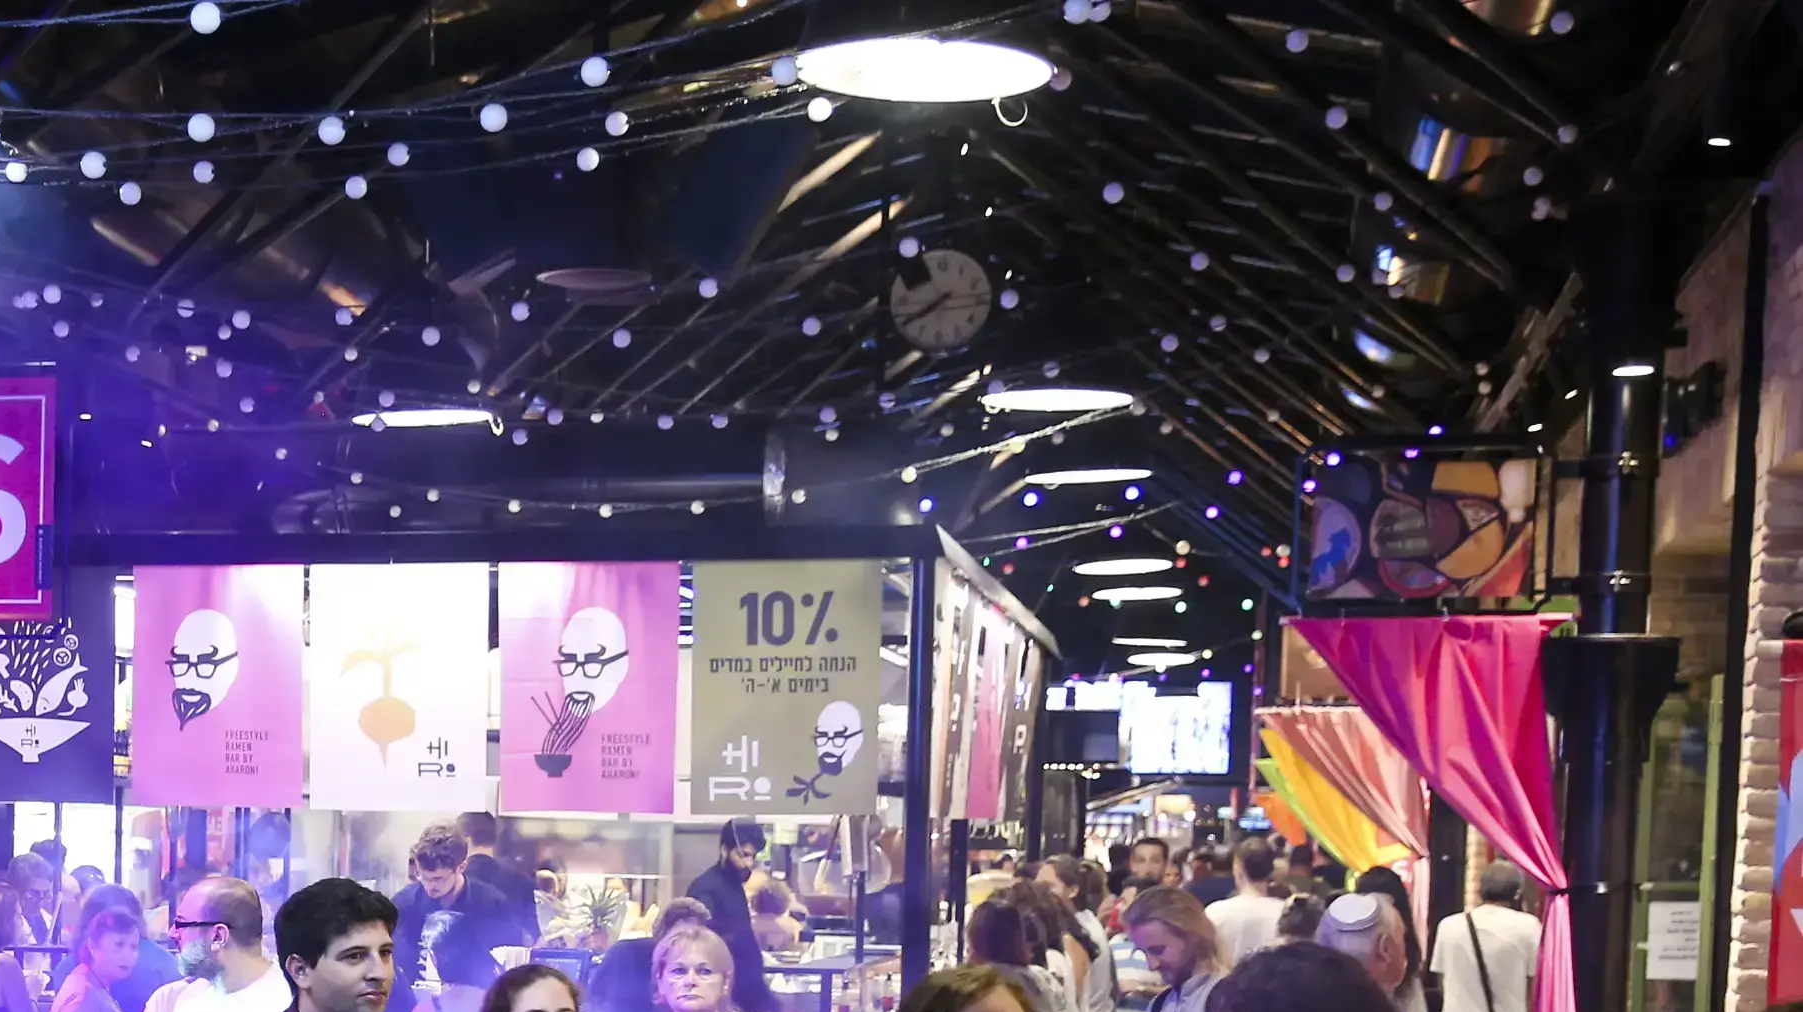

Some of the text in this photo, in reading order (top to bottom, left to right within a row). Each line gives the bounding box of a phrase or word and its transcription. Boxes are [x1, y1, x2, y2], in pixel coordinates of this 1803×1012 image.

[739, 590, 838, 646] 10%
[709, 656, 857, 673] הנחה לחיילים במדים
[788, 677, 829, 693] בימים
[225, 741, 252, 751] RAMEN
[426, 737, 448, 760] HI
[722, 735, 759, 772] HI
[242, 753, 254, 764] BY
